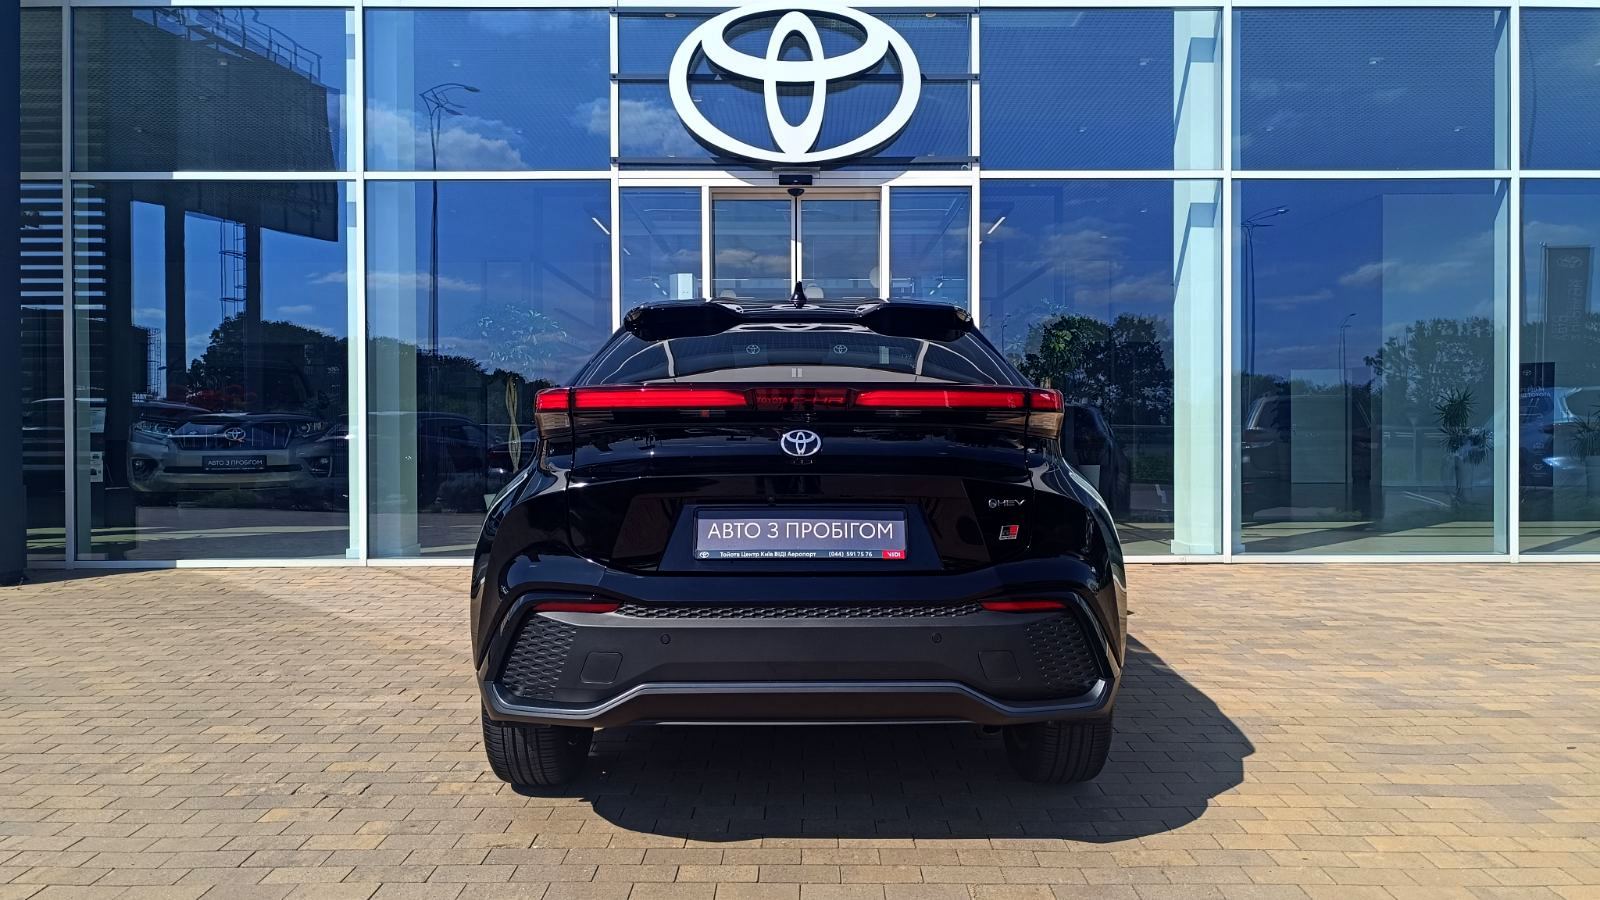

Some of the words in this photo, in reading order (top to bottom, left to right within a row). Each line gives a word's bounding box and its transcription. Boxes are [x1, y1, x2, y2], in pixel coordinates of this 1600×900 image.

[997, 499, 1025, 507] HEV
[707, 522, 761, 539] АВТО
[767, 522, 779, 539] З
[786, 522, 893, 539] ПРОБІГОМ
[741, 551, 760, 559] Центр
[760, 550, 774, 558] Київ
